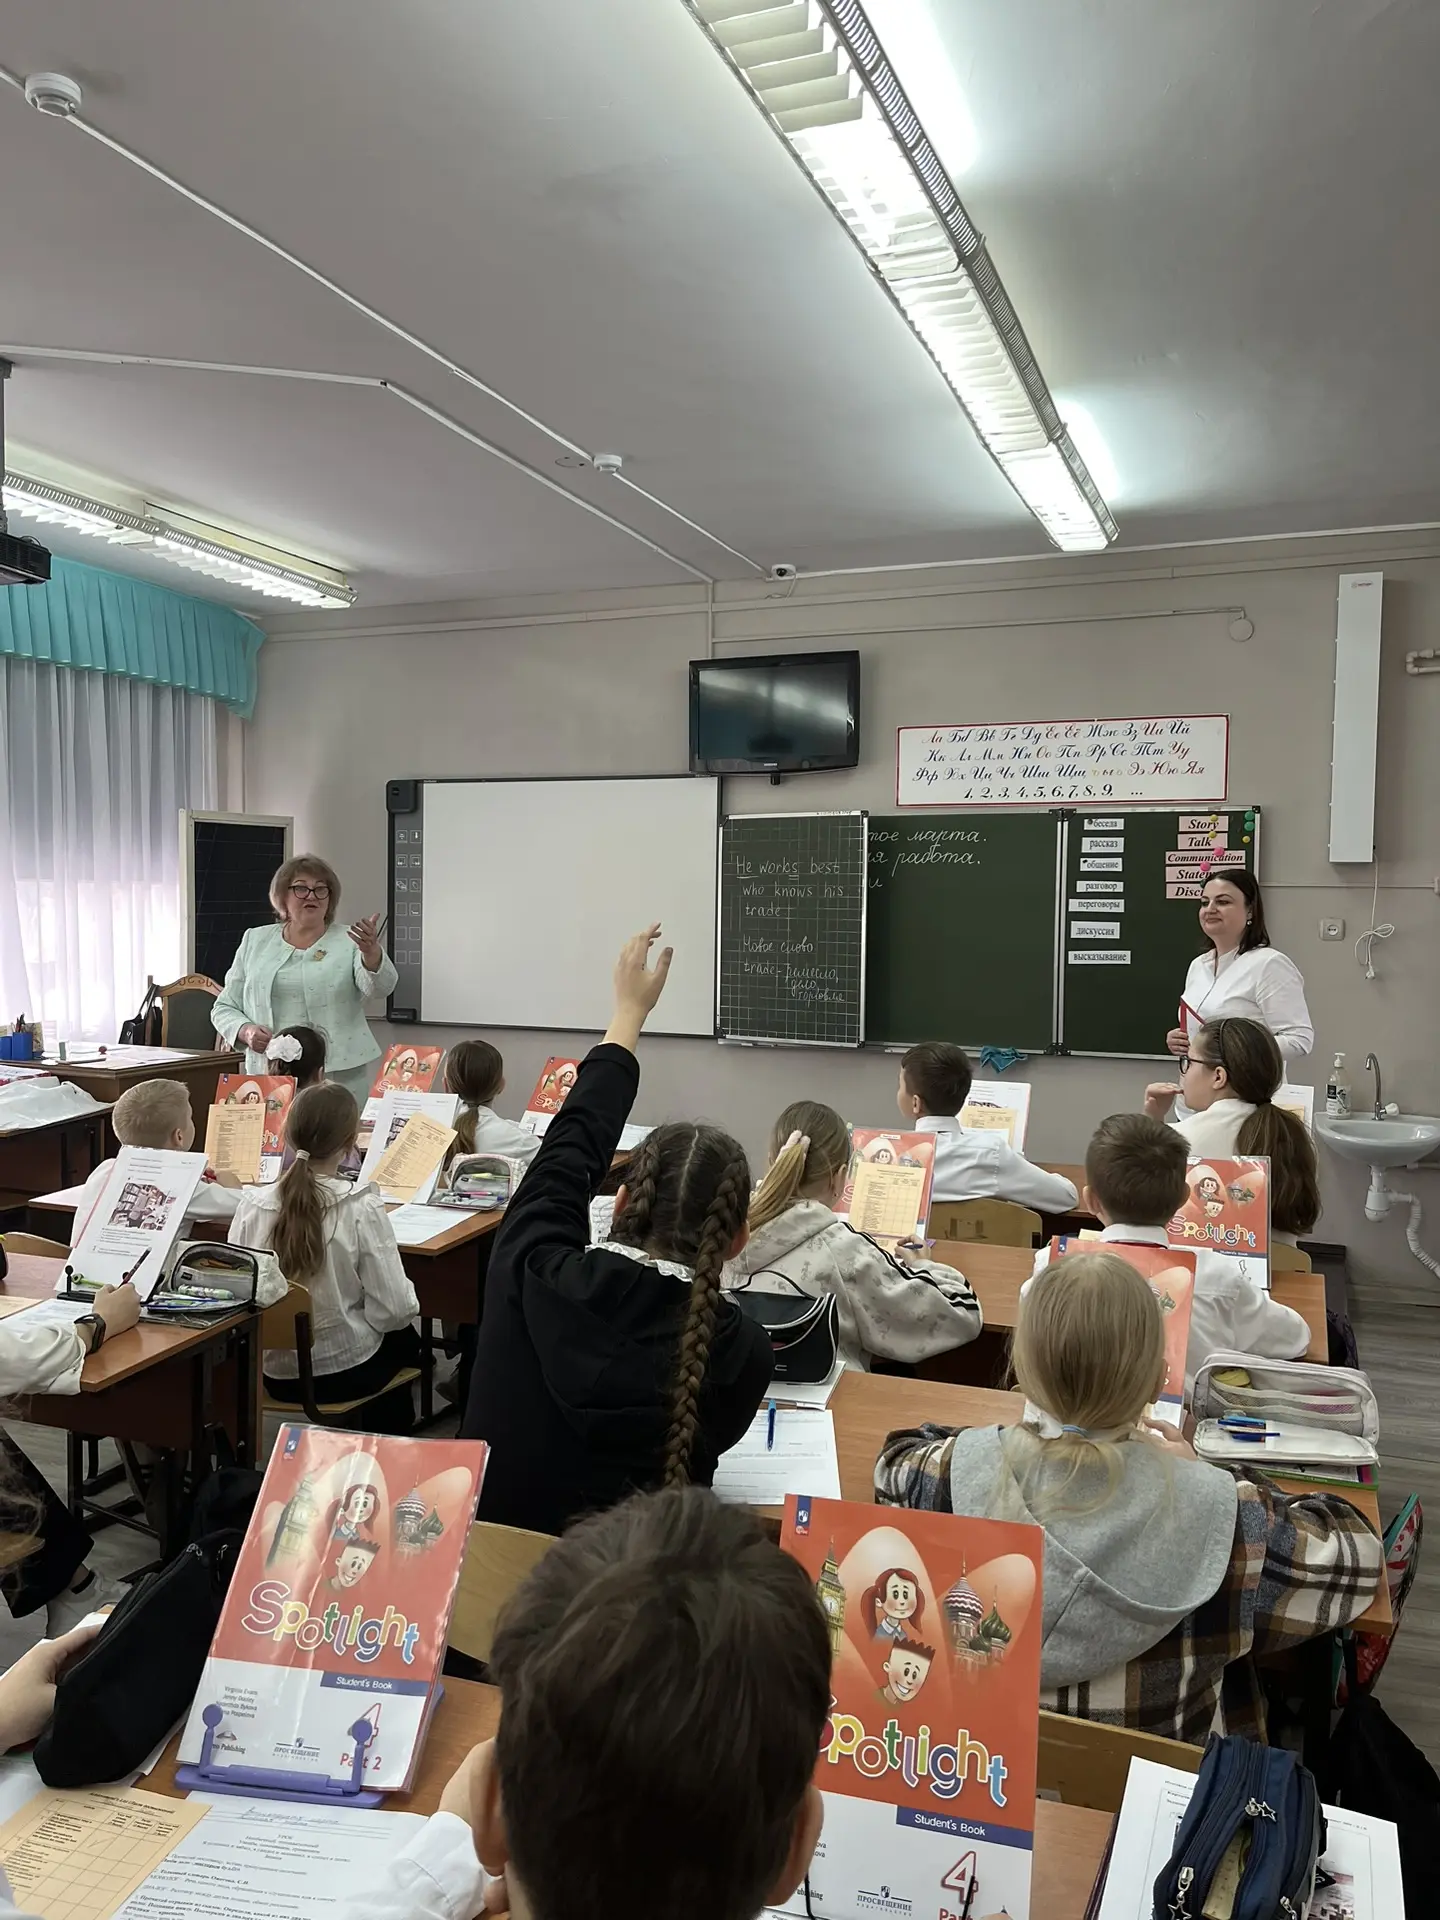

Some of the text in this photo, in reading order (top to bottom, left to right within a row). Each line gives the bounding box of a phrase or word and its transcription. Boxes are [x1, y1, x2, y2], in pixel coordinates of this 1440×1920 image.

[1093, 819, 1118, 828] беседа
[1188, 818, 1219, 831] Story
[907, 829, 987, 846] марта.
[1188, 837, 1212, 847] Talk
[1089, 840, 1118, 850] рассказ
[1086, 860, 1119, 869] общение
[1167, 853, 1243, 863] Communication
[736, 855, 840, 875] He works best
[743, 881, 844, 898] who knows his
[1085, 883, 1118, 891] разговор
[1077, 901, 1120, 910] переговоры
[1075, 927, 1115, 938] дискуссия
[1073, 953, 1127, 961] высказывание
[1167, 1215, 1256, 1248] Spotlight
[241, 1580, 420, 1666] Spotlight
[336, 1676, 392, 1690] Student's Book
[340, 1752, 382, 1770] Pat 2
[914, 1813, 986, 1837] Student's Book
[941, 1850, 978, 1905] 4
[857, 1894, 913, 1912] ПРОСВЕЩЕНИЕ
